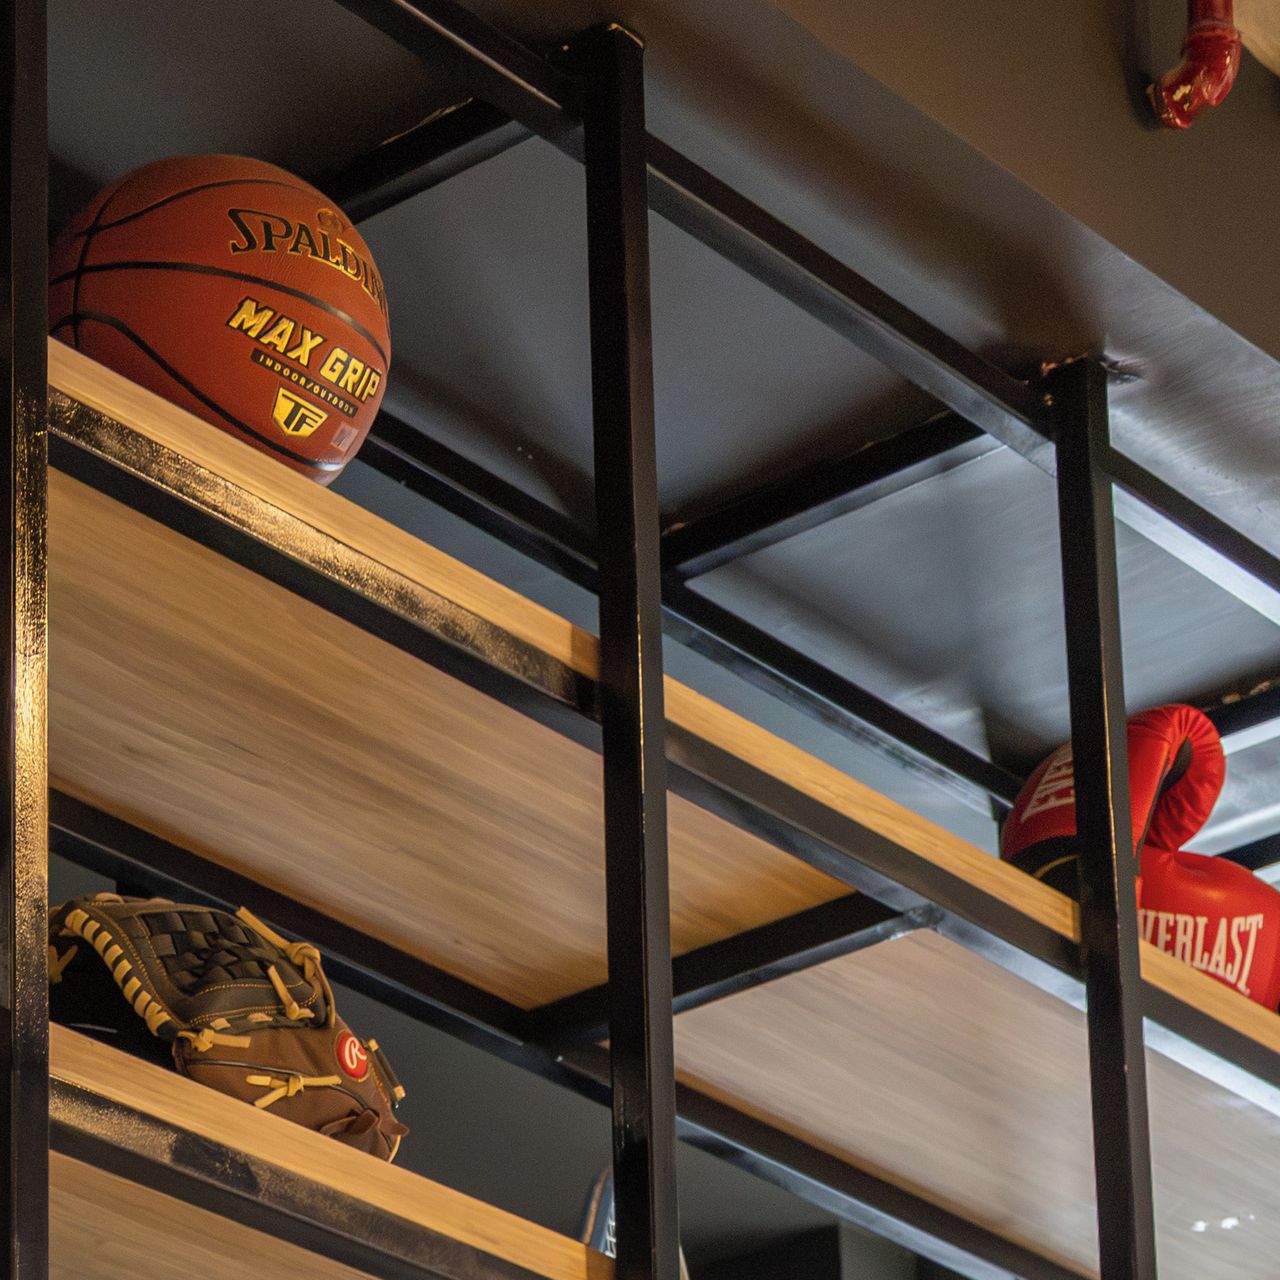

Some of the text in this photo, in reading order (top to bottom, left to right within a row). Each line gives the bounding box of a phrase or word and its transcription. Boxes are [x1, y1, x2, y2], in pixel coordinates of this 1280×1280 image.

[228, 207, 387, 318] SPALDIN
[225, 296, 383, 404] MAX GRIP
[258, 353, 355, 415] INDOOR/OUTDOOR
